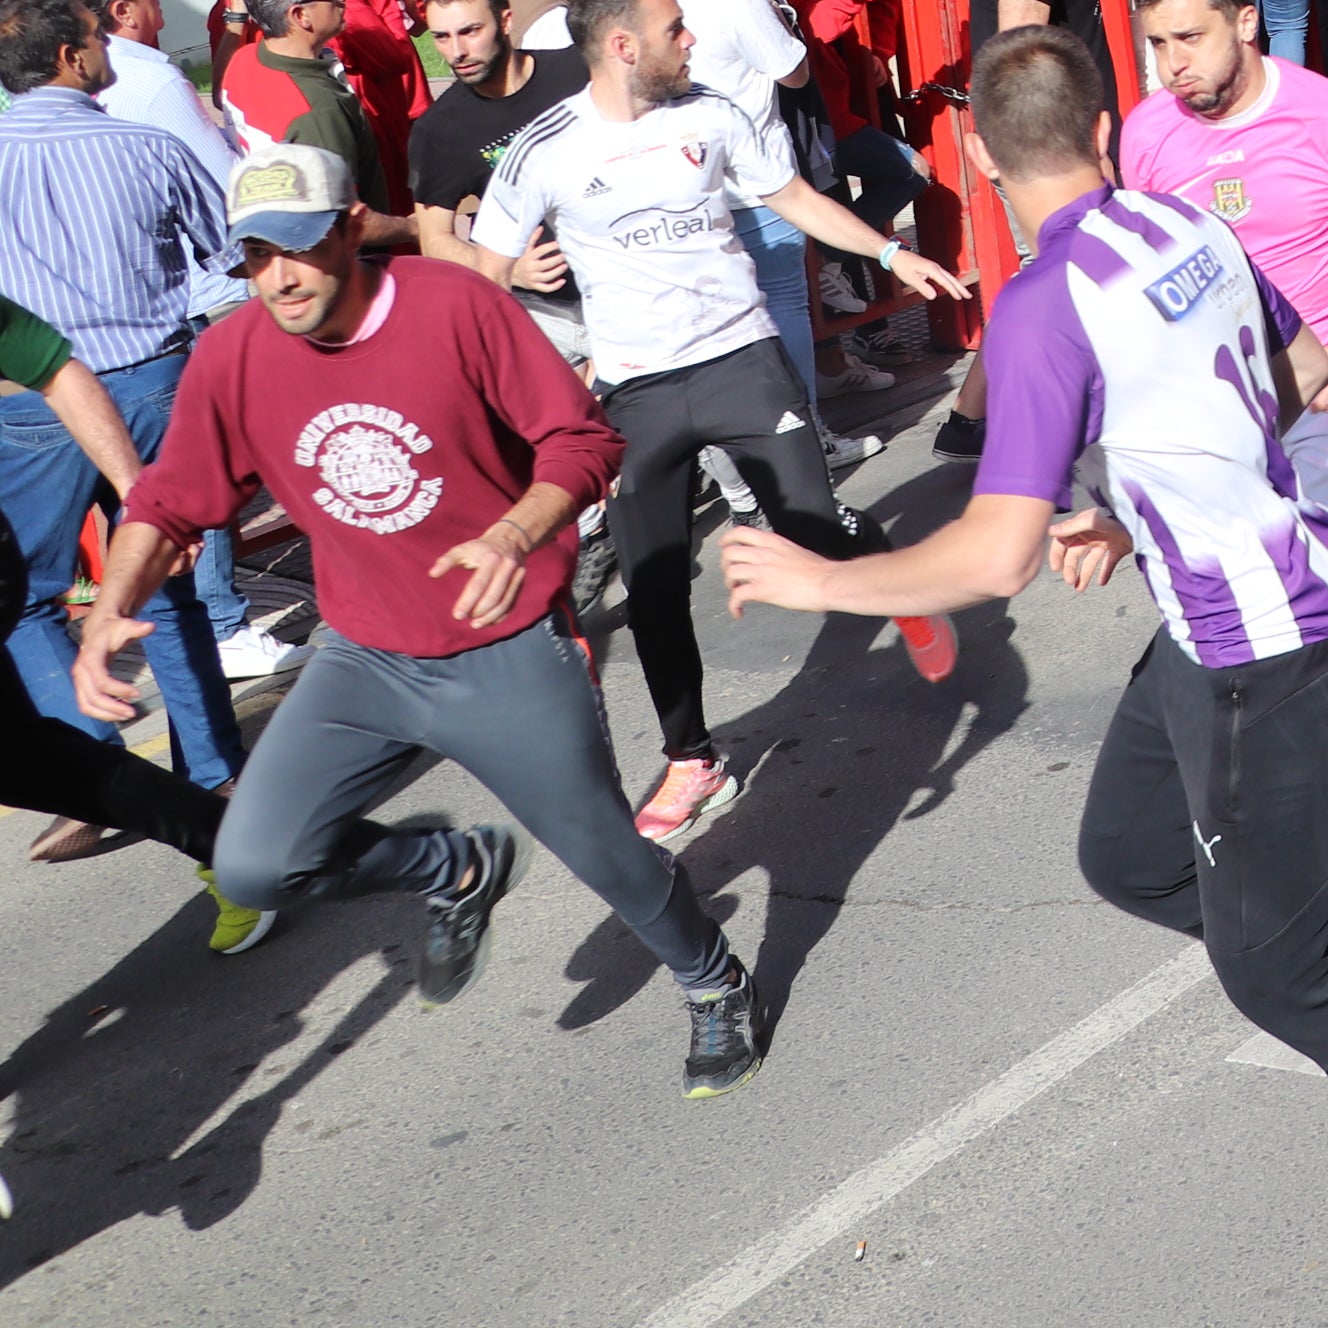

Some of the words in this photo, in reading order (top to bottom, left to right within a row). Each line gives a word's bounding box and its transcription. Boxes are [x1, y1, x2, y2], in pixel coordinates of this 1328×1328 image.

[612, 209, 714, 249] verleal
[1158, 247, 1224, 313] OMEGA
[293, 402, 434, 468] UNIVERSIDAD
